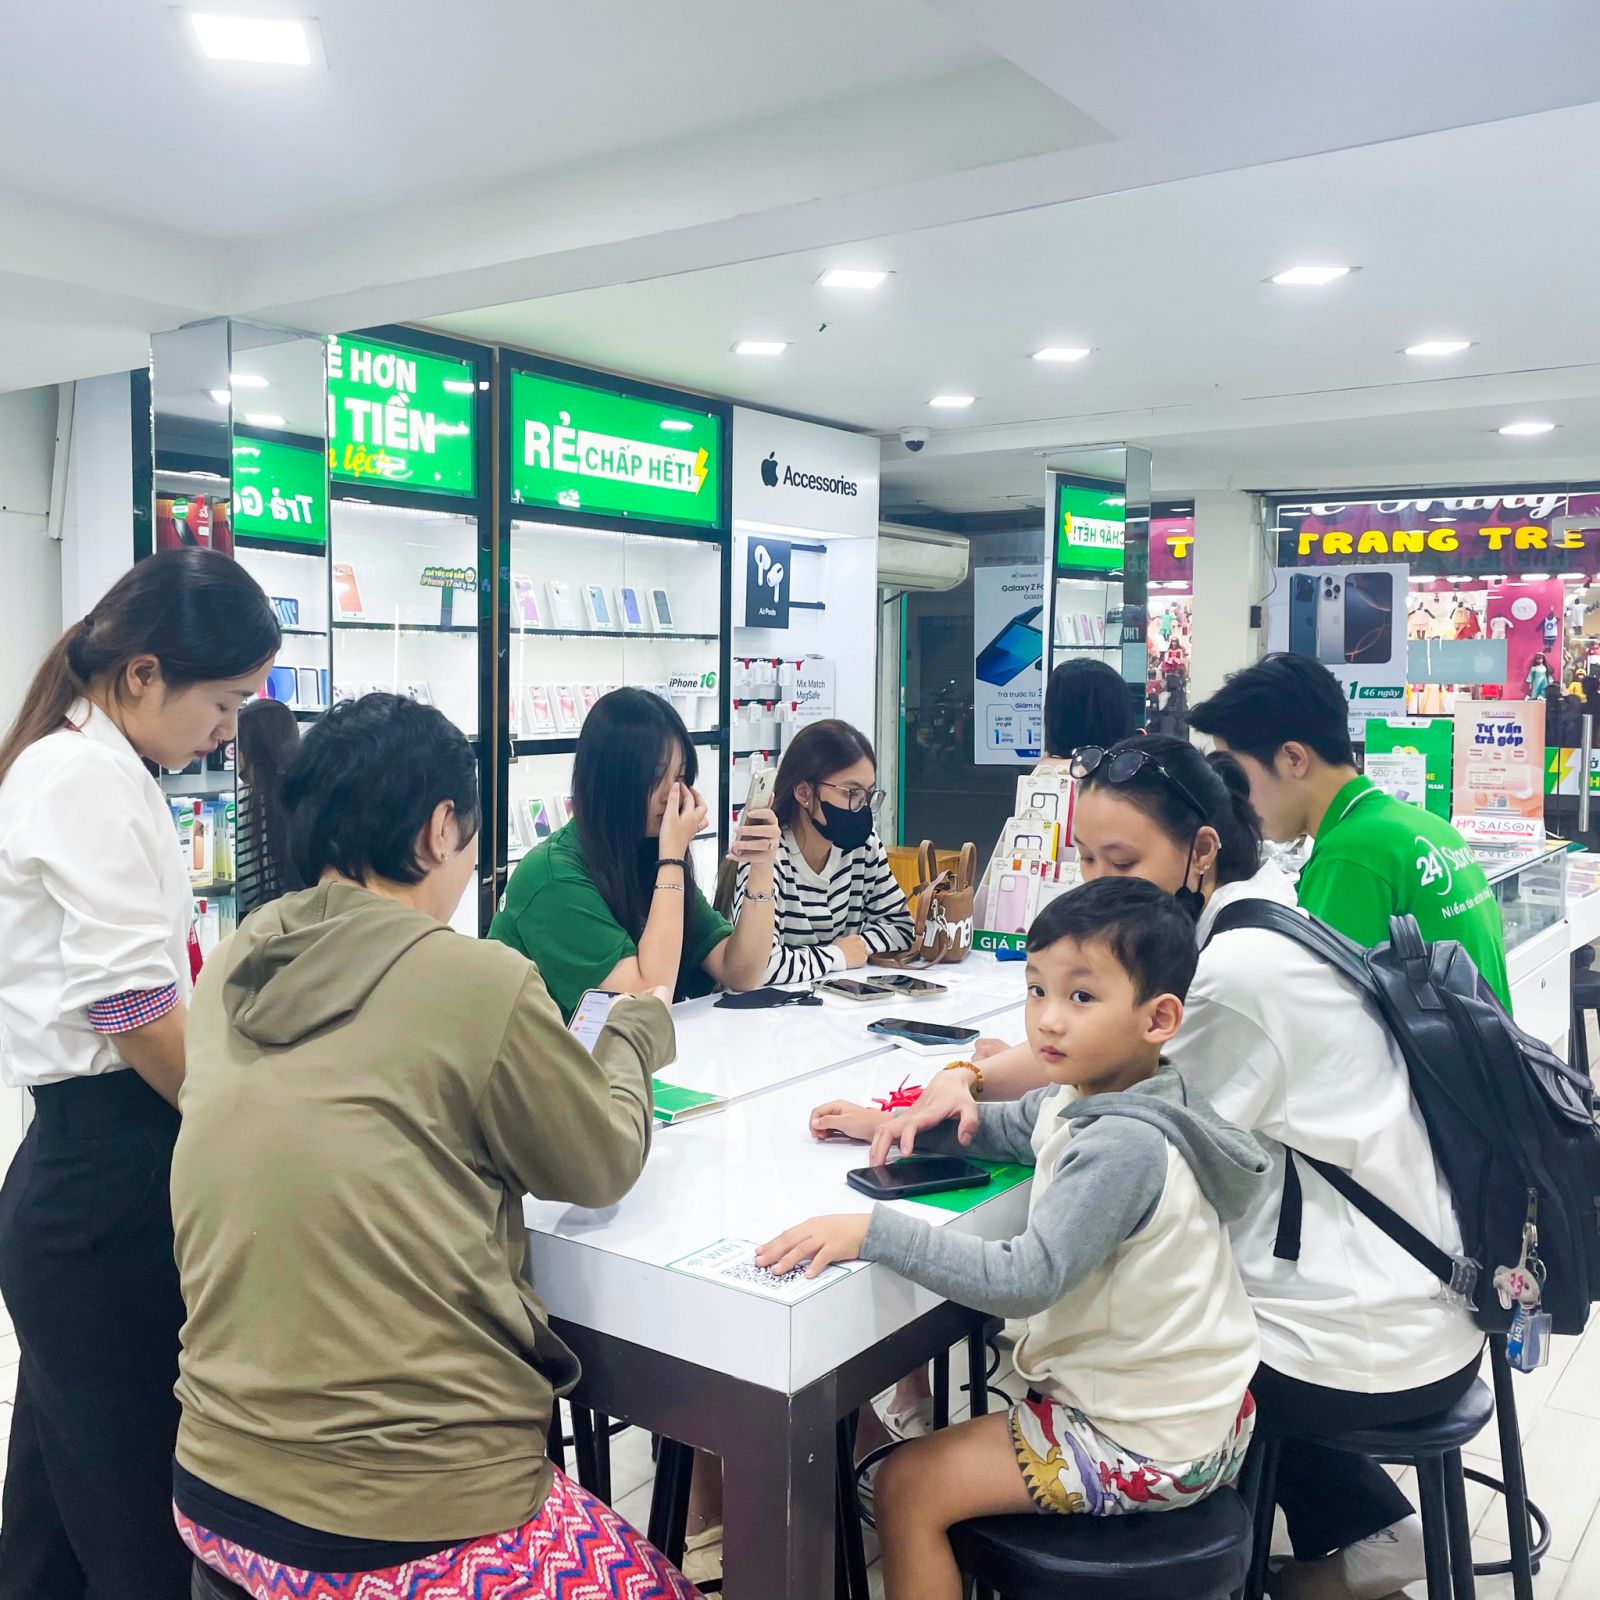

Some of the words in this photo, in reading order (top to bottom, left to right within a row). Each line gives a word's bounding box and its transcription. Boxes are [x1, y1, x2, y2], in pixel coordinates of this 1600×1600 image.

[350, 348, 416, 393] HƠN
[344, 392, 436, 454] TIỀN
[523, 411, 581, 474] RẺ
[585, 445, 642, 477] CHẤP
[648, 453, 692, 486] HẾT!
[783, 465, 858, 496] Accessories
[1298, 528, 1459, 555] TRANG
[1001, 584, 1030, 593] Galaxy
[758, 607, 777, 617] AirPods
[669, 678, 698, 688] iPhone
[700, 671, 717, 689] 16
[796, 679, 806, 689] Mix
[808, 679, 826, 689] Match
[796, 691, 821, 702] MagSafe
[1349, 681, 1358, 700] 1
[1363, 688, 1375, 696] 46
[1377, 687, 1400, 698] ngày
[1497, 721, 1522, 733] vấn
[1497, 733, 1523, 747] góp
[1456, 819, 1476, 829] HD
[1478, 821, 1536, 832] SAISON
[1416, 851, 1443, 887] 24
[980, 935, 1010, 949] GIÁ
